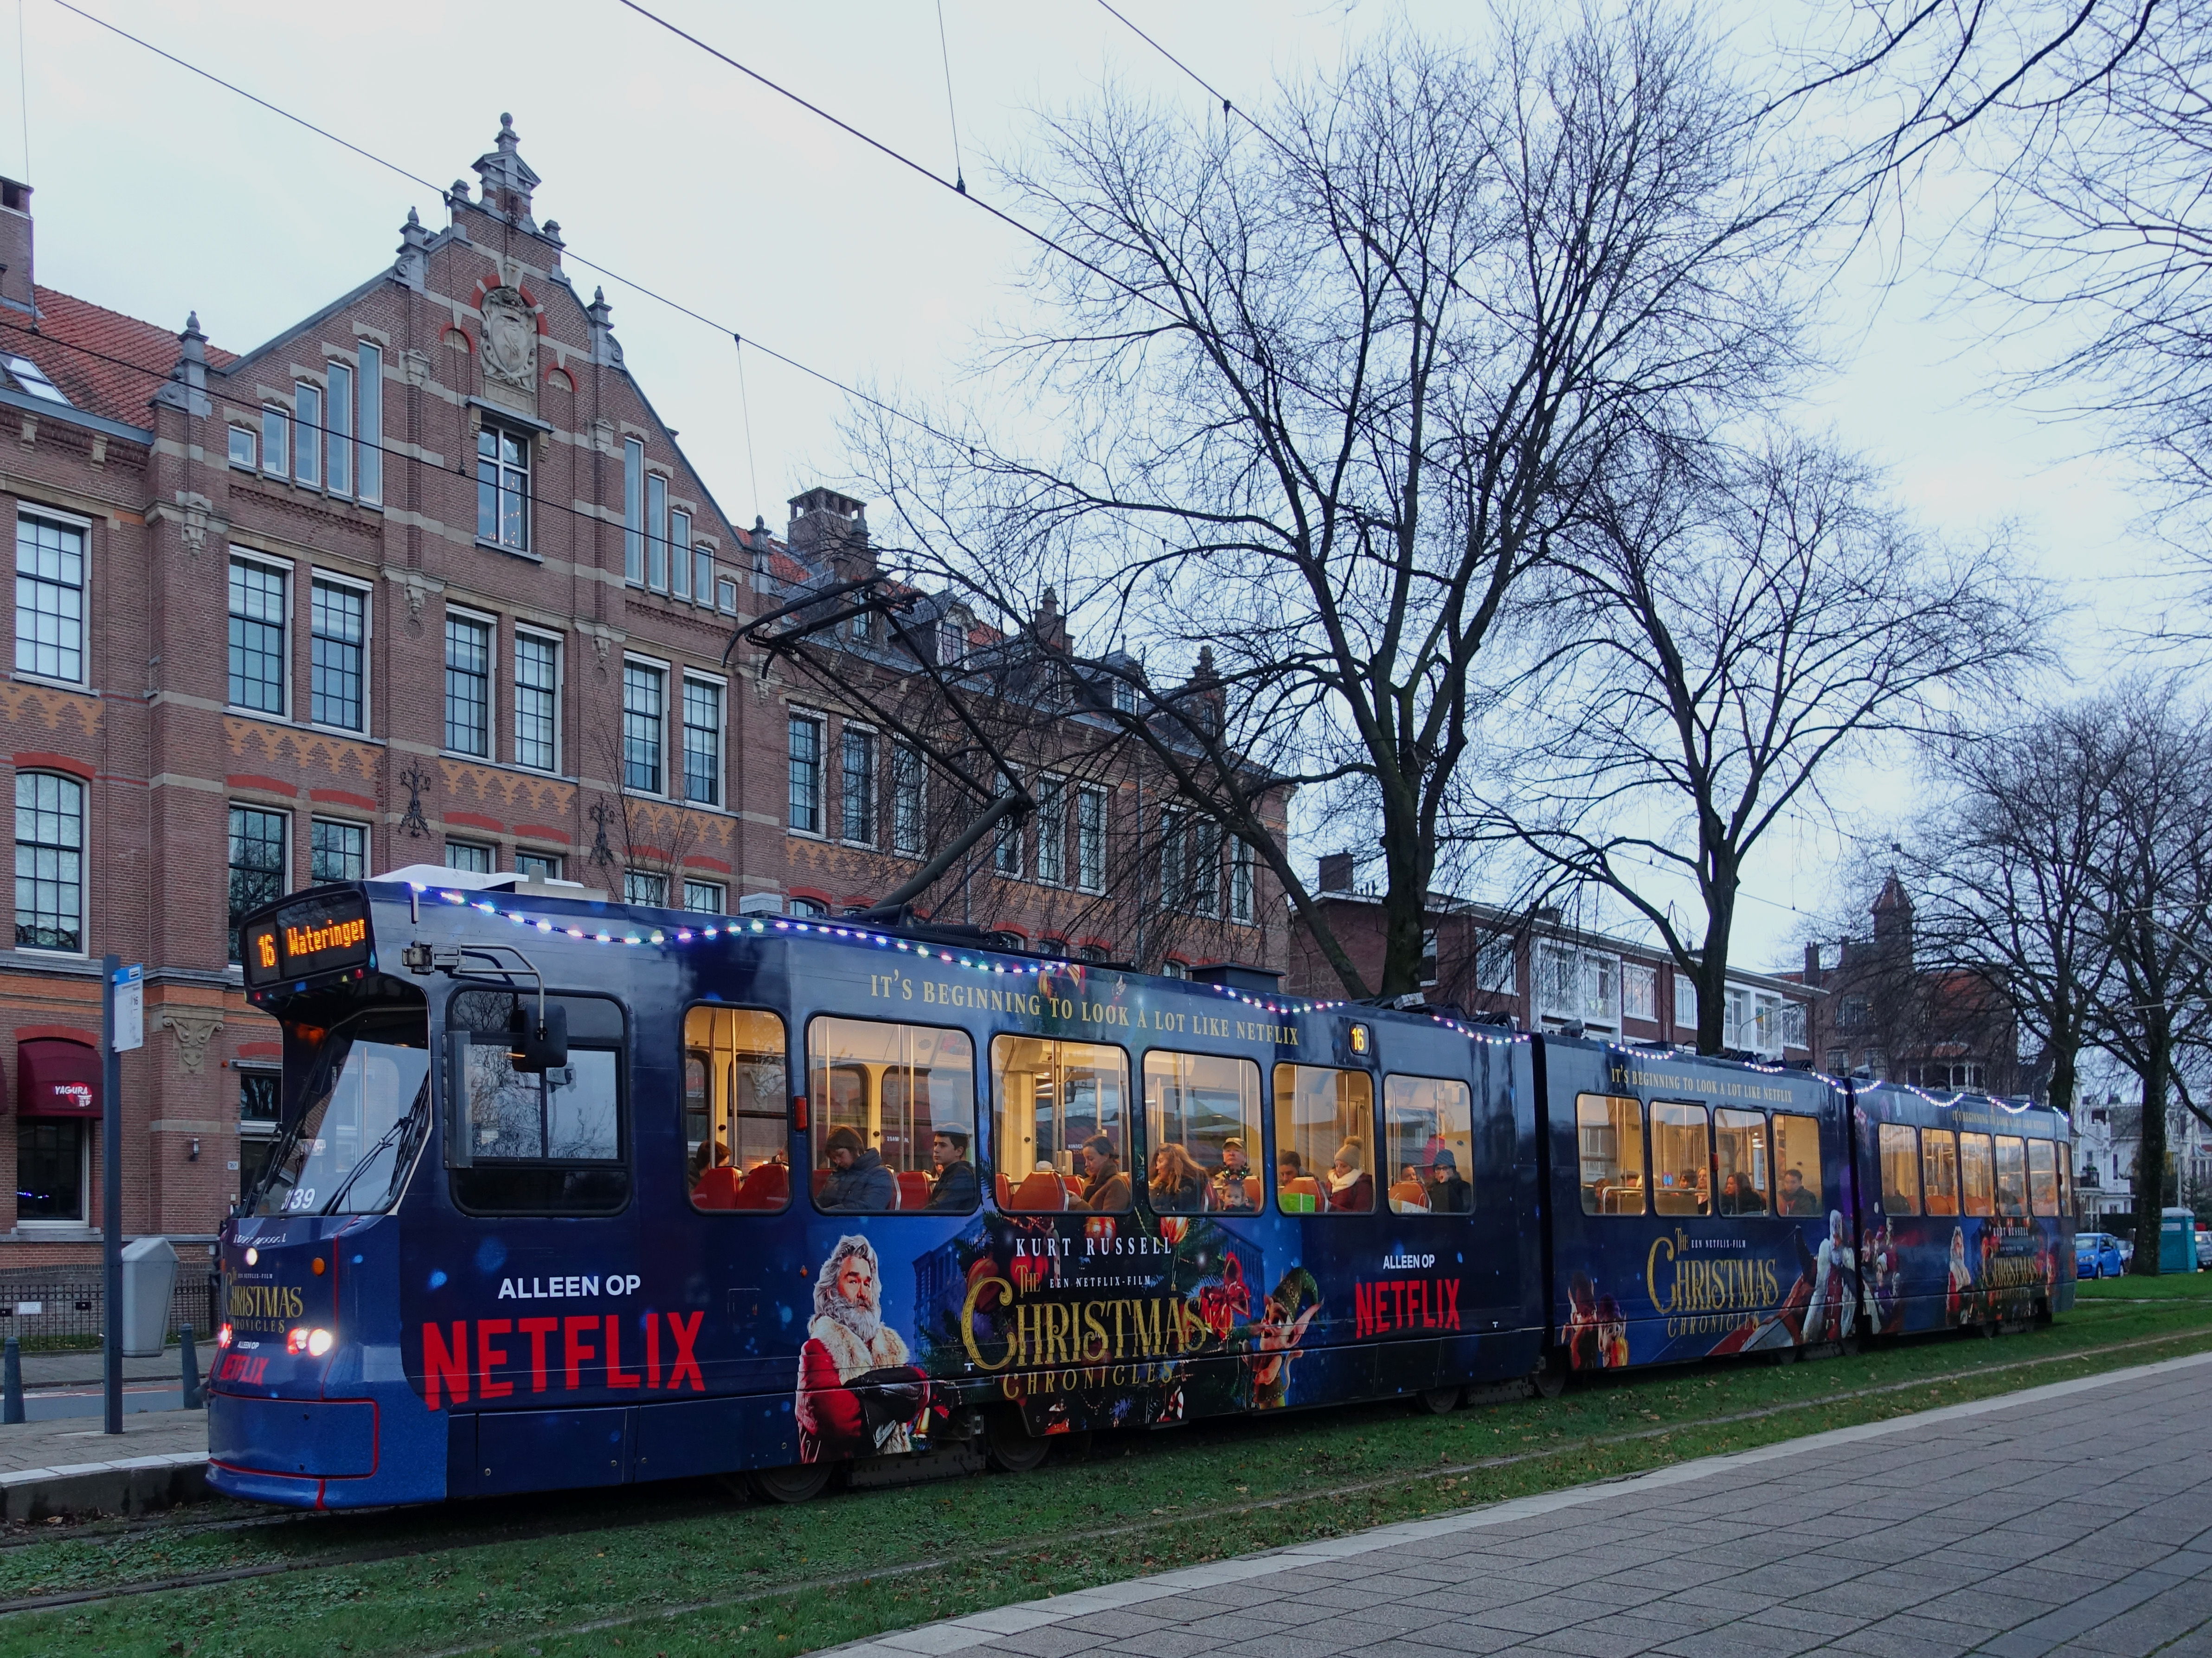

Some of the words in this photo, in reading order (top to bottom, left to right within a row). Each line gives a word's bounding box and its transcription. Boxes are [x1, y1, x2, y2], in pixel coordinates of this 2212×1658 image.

[258, 934, 276, 967] 16
[871, 969, 912, 1000] IT'S
[923, 981, 1040, 1015] BEGINNING
[1049, 998, 1072, 1019] TO
[1081, 1002, 1129, 1026] LOOK
[1137, 1009, 1147, 1028] A
[1155, 1011, 1185, 1032] LOT
[1193, 1016, 1228, 1037] LIKE
[1237, 1021, 1299, 1046] NETFLIX
[1352, 1028, 1364, 1051] 16
[55, 1086, 88, 1095] YAGURA
[1612, 1064, 1628, 1083] IT'S
[1632, 1071, 1680, 1090] BEGINNING
[1683, 1078, 1693, 1091] TO
[1697, 1079, 1717, 1094] LOOK
[1720, 1082, 1724, 1095] A
[1728, 1083, 1741, 1097] LOT
[1744, 1085, 1761, 1099] LIKE
[1763, 1086, 1792, 1103] NETFLIX
[281, 1188, 315, 1210] 3139
[1016, 1238, 1070, 1257] KURT
[1087, 1237, 1171, 1256] RUSSELL
[1675, 1227, 1689, 1255] THE
[1383, 1254, 1420, 1269] ALLEEN
[1421, 1254, 1435, 1268] OP
[1647, 1236, 1779, 1313] CHRISTMAS
[225, 1272, 303, 1318] CHRISTMAS
[498, 1275, 599, 1298] ALLEEN
[606, 1275, 641, 1296] OP
[1015, 1265, 1041, 1298] THE
[1050, 1279, 1068, 1288] EEN
[1076, 1275, 1151, 1287] NETFLIX-FILM
[961, 1277, 1207, 1370] CHRISTMAS
[1355, 1279, 1460, 1339] NETFLIX
[1668, 1311, 1760, 1337] CHRONICLES
[423, 1311, 706, 1411] NETFLIX
[1003, 1362, 1172, 1399] CHRONICLES
